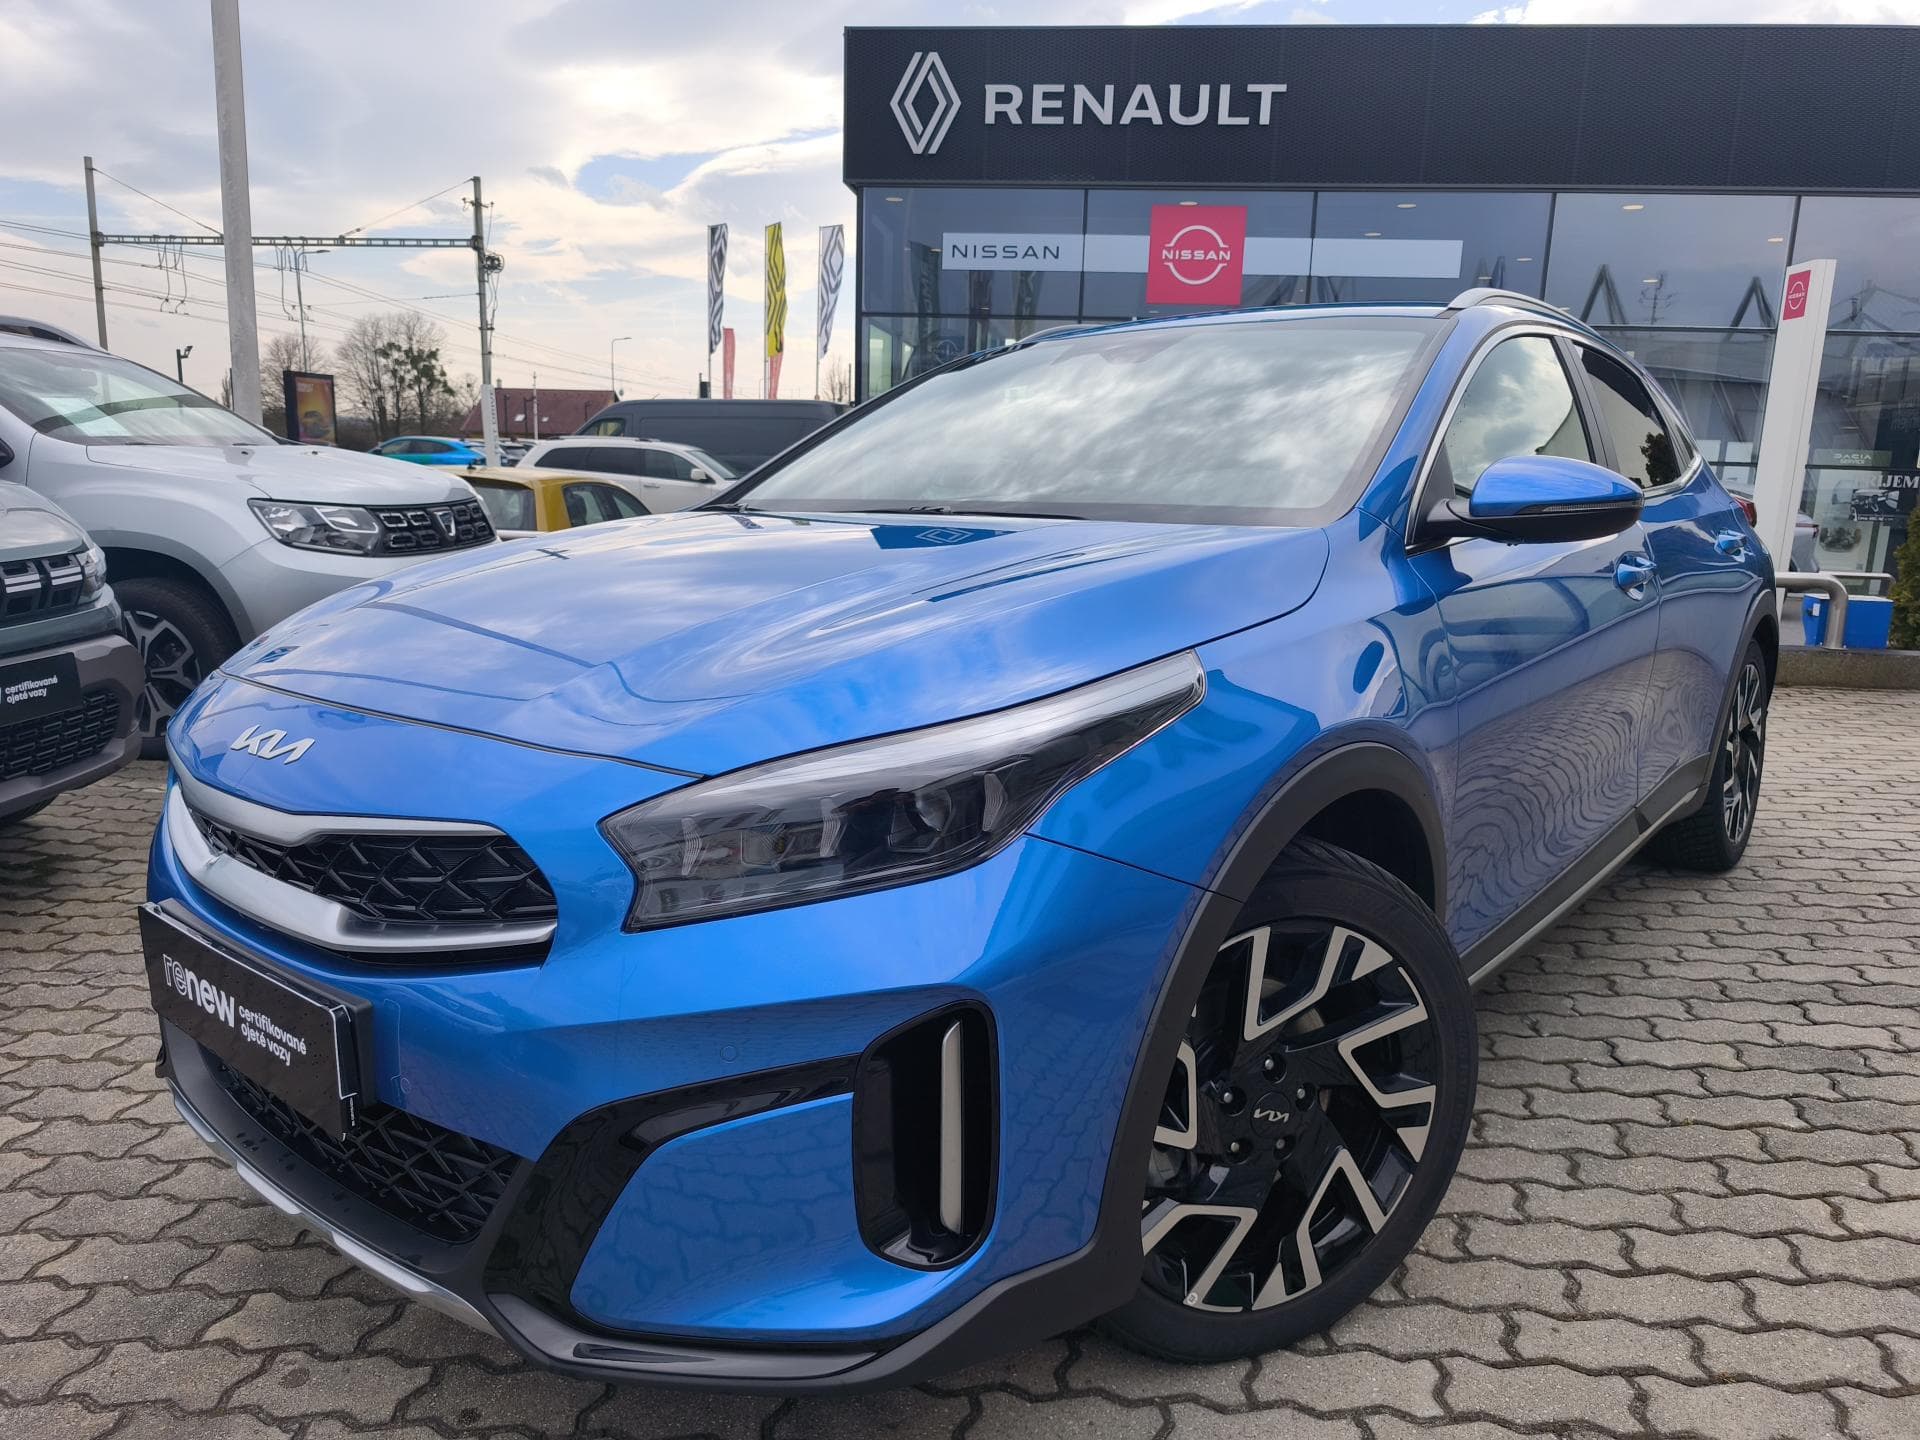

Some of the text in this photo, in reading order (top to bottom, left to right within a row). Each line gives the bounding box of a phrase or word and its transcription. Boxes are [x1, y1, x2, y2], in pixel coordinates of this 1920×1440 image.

[984, 84, 1288, 126] RENAULT
[951, 244, 1060, 260] NISSAN
[1161, 248, 1231, 261] NISSAN
[5, 674, 58, 694] certifikované
[6, 688, 47, 704] ojeté vozy
[230, 724, 315, 765] KIA
[162, 953, 235, 1028] renew
[239, 1005, 307, 1055] certifikované
[240, 1023, 291, 1067] ojeté vozy
